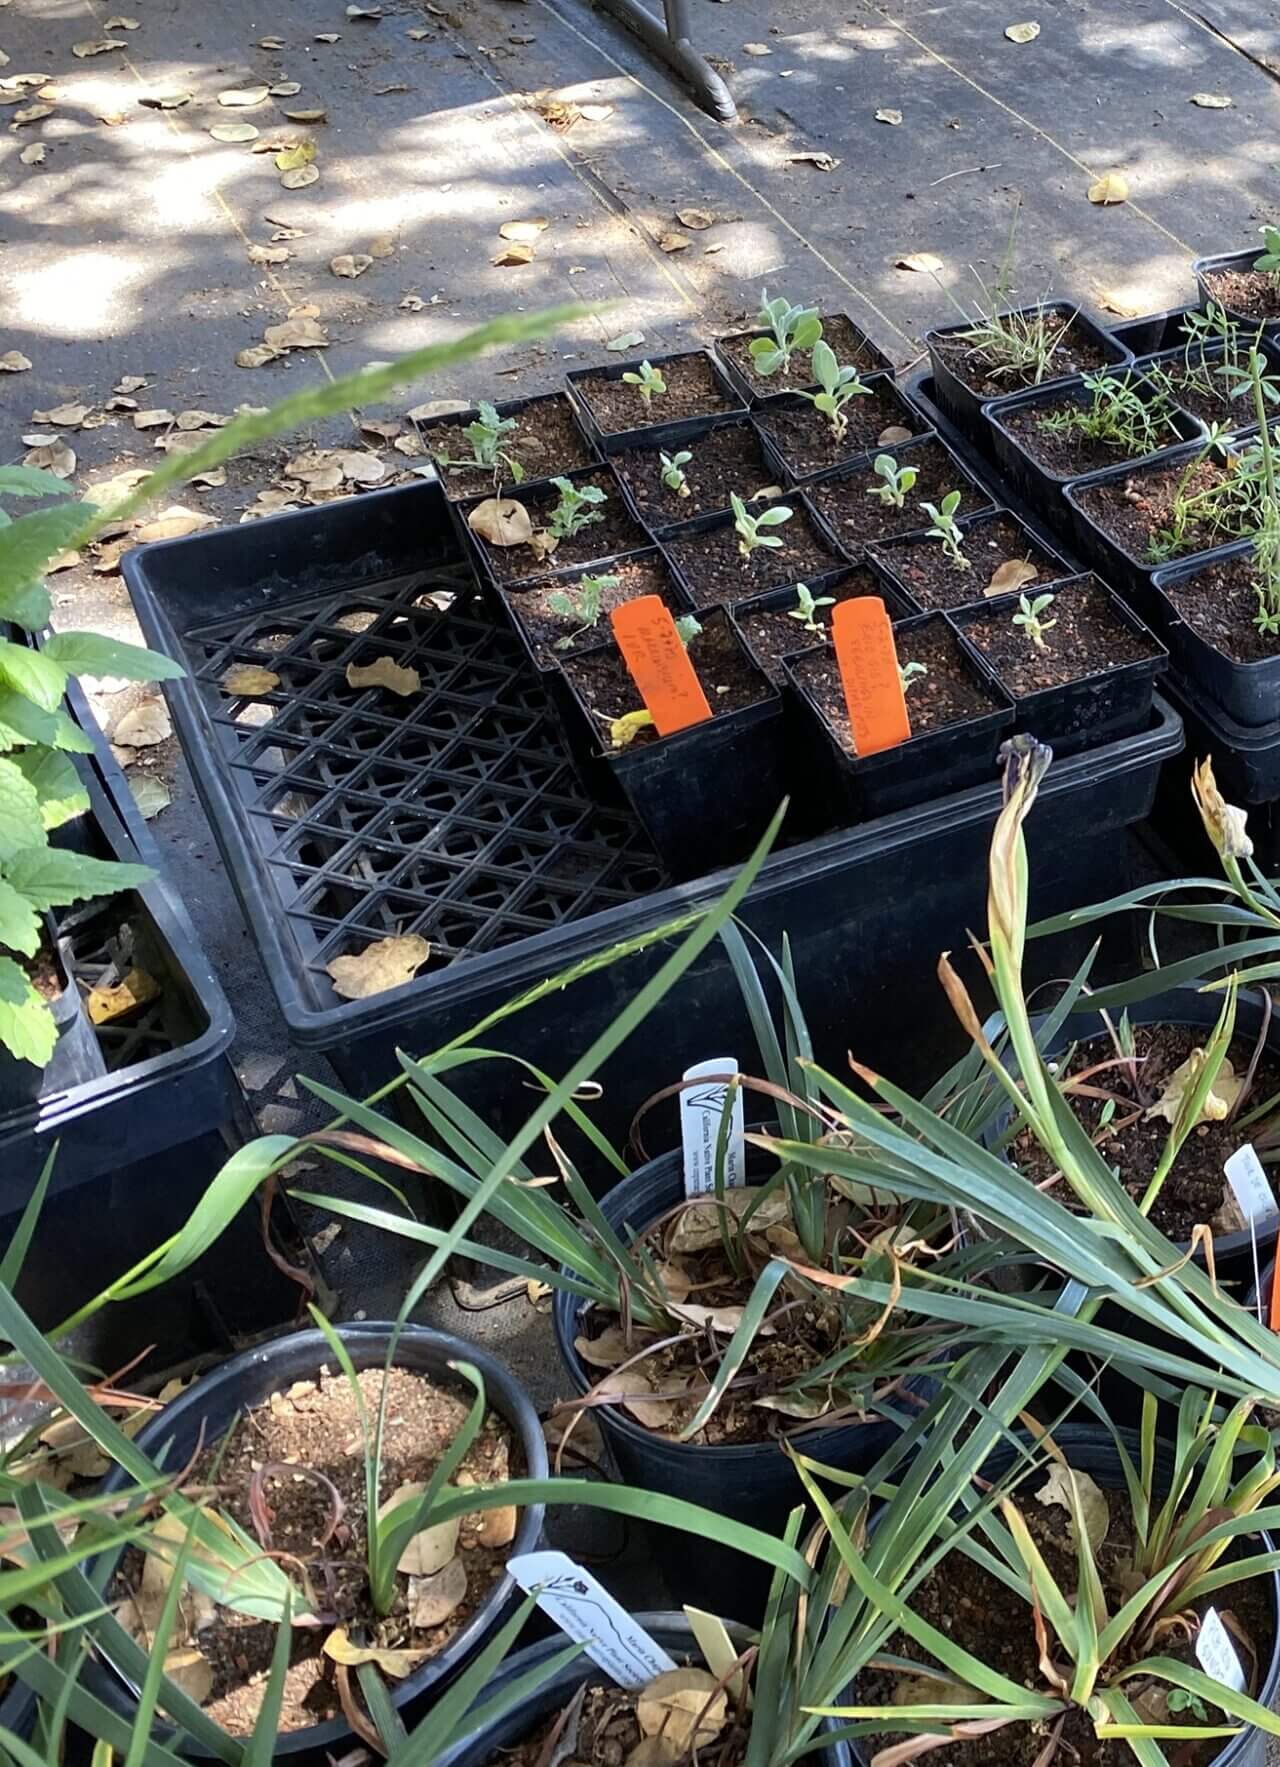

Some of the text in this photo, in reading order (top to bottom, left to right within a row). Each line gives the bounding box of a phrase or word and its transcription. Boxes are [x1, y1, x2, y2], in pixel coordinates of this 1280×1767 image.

[702, 1110, 711, 1142] California
[703, 1143, 712, 1165] Native
[704, 1166, 712, 1182] Plant
[556, 1596, 588, 1629] California
[607, 1647, 625, 1665] Plant
